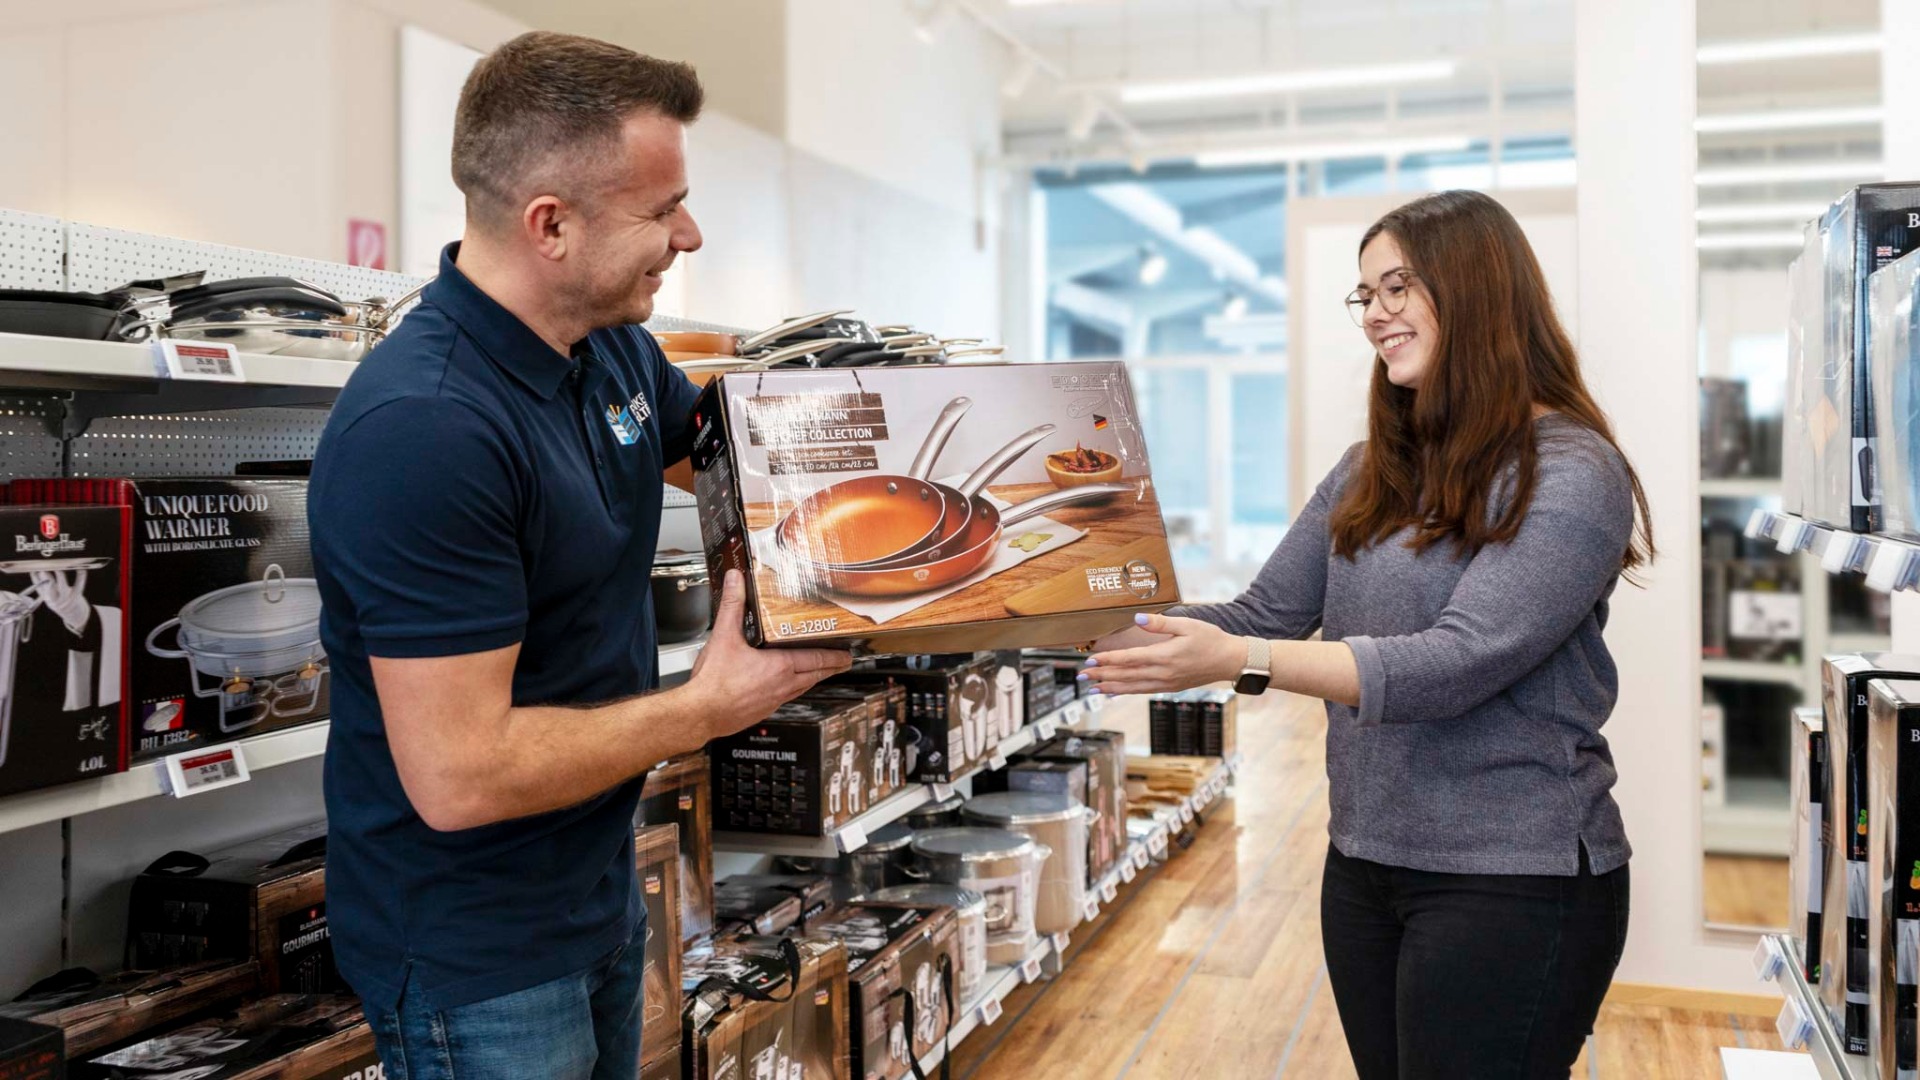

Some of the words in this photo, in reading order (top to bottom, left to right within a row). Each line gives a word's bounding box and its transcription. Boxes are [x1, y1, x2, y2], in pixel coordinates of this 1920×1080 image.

[809, 427, 873, 441] COLLECTION
[144, 495, 218, 519] UNIQUE
[219, 494, 268, 513] FOOD
[145, 517, 231, 540] WARMER
[144, 543, 171, 553] WITH
[172, 539, 235, 552] BOROSILICATE
[235, 537, 261, 548] GLASS
[1131, 565, 1146, 573] NEW
[1088, 576, 1122, 592] FREE
[780, 617, 838, 635] BL-3280F
[732, 749, 775, 760] GOURMET
[776, 751, 797, 761] LINE
[283, 928, 324, 954] GOURMET
